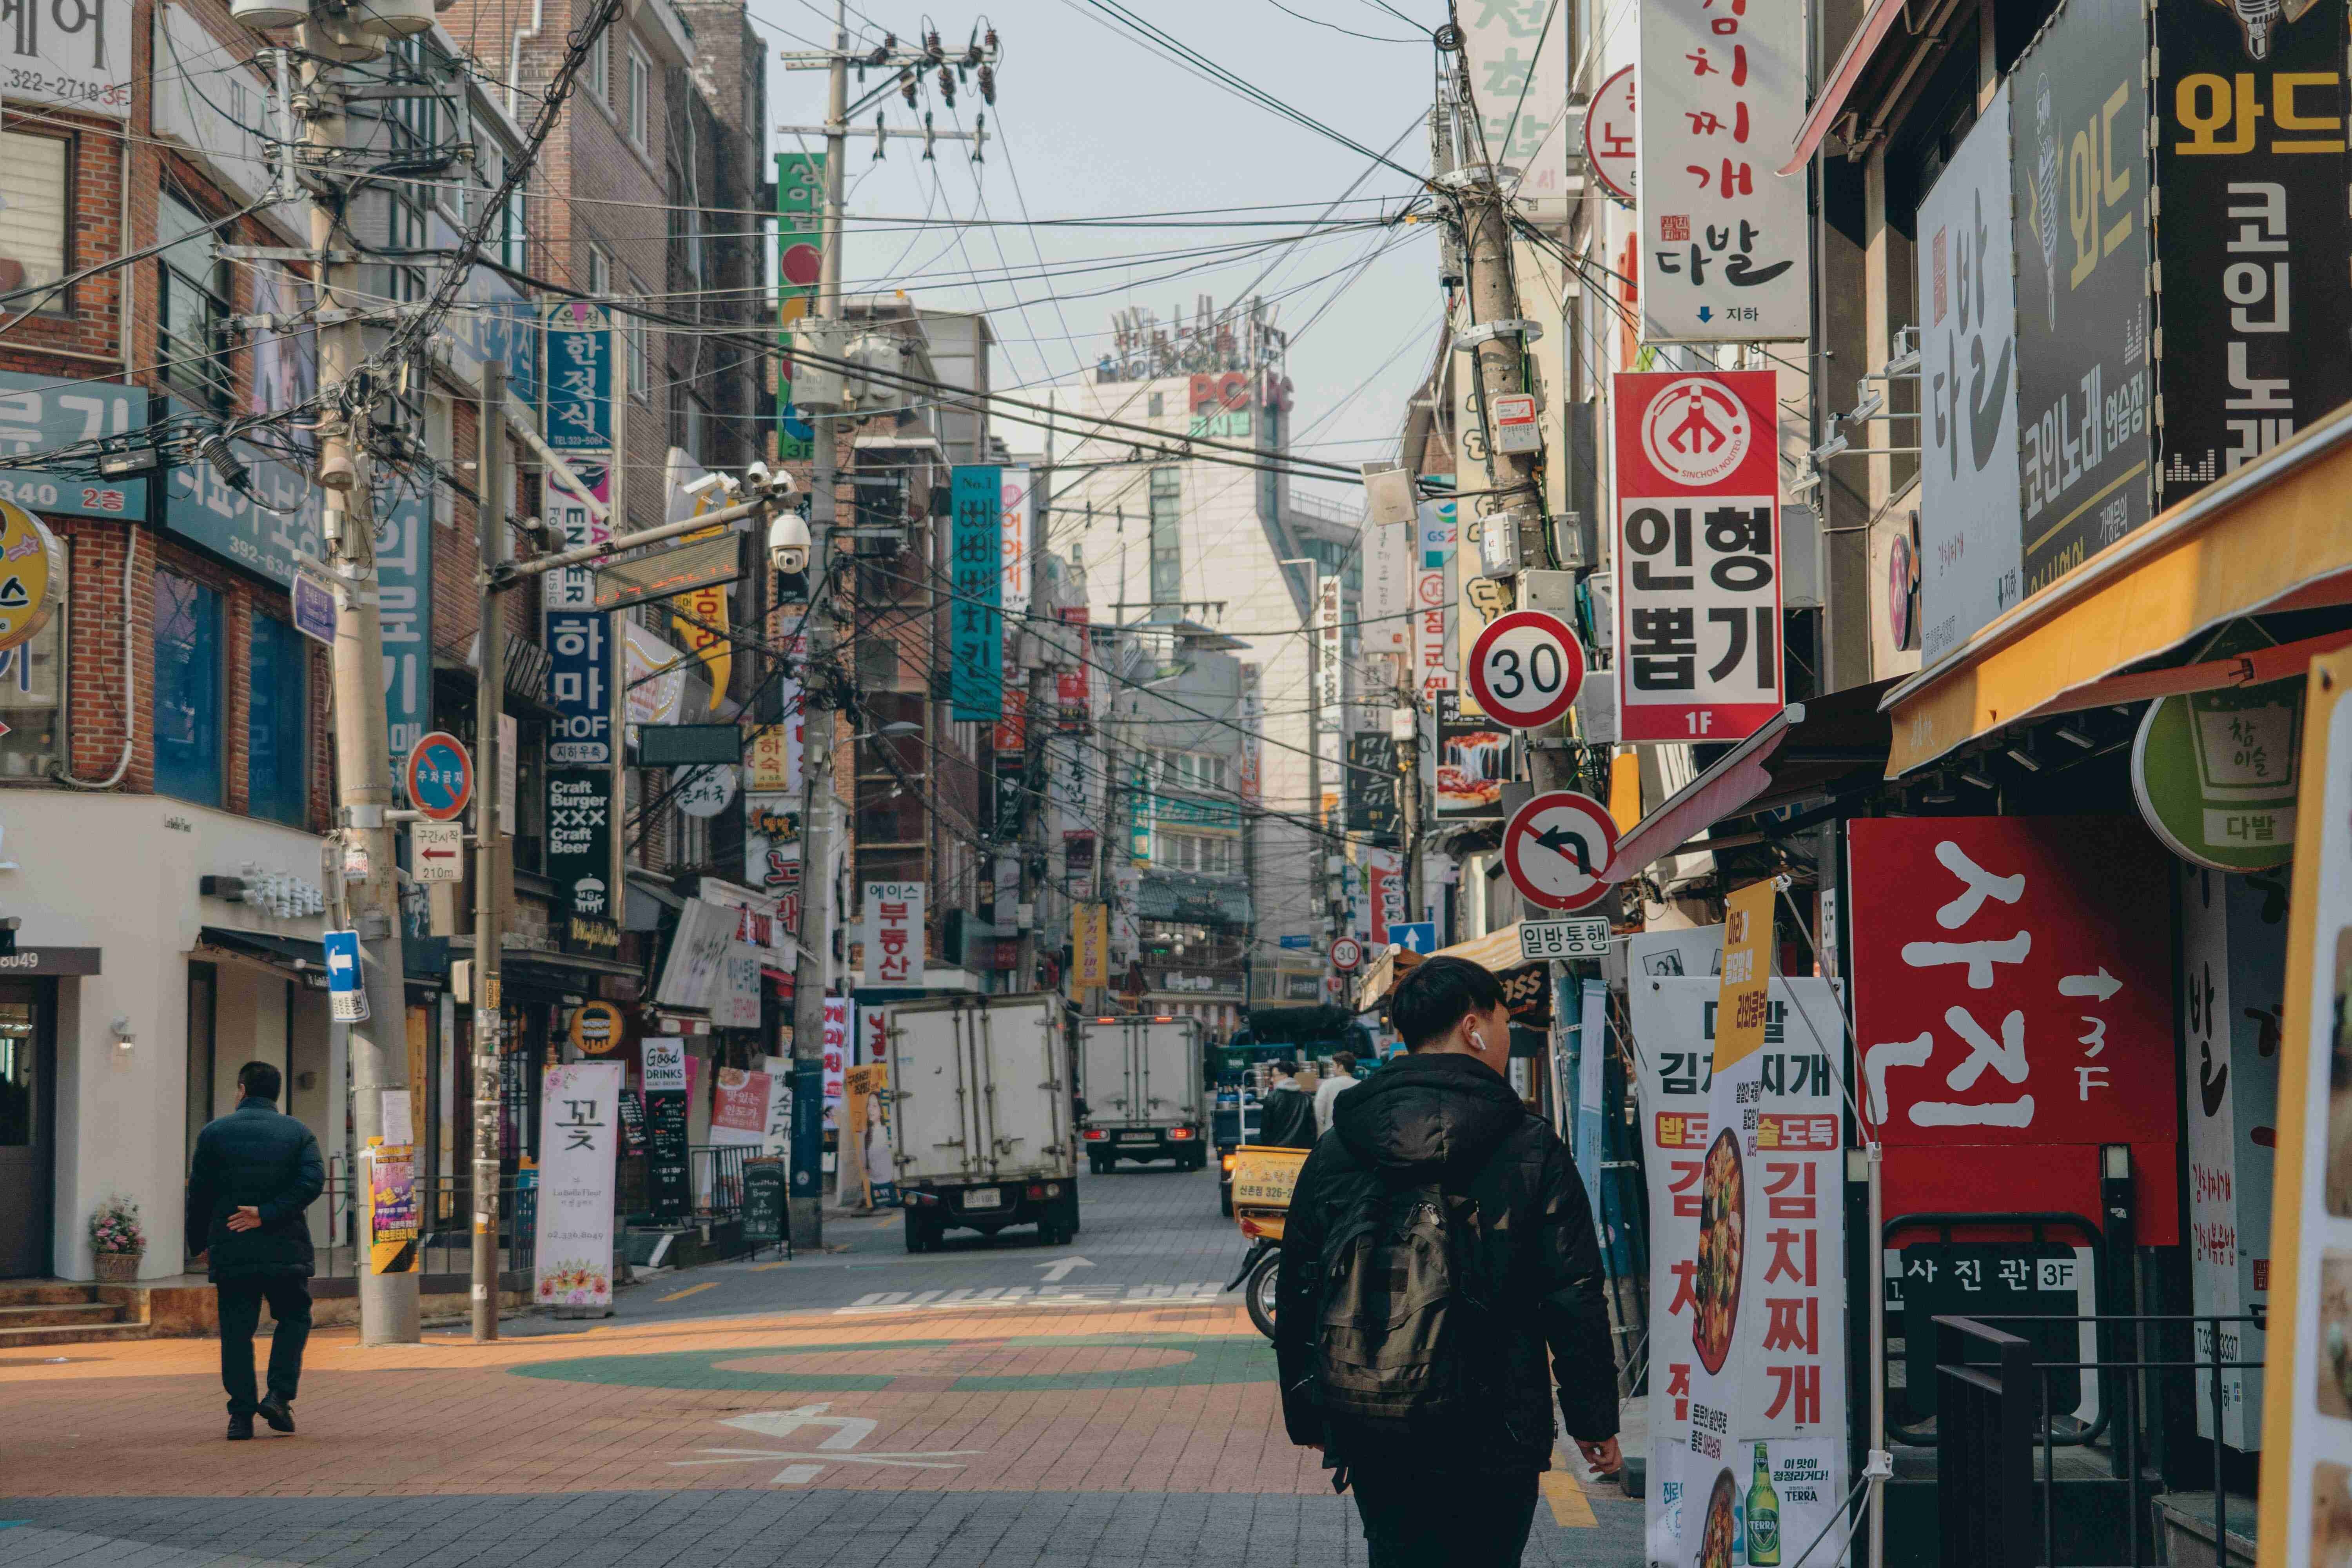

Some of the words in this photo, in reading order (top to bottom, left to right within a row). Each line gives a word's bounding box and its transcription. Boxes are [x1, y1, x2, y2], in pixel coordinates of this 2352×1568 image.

[2175, 73, 2345, 154] 와드
[2070, 80, 2132, 292] 와드
[1655, 219, 1794, 286] 다발
[1726, 307, 1759, 321] 지하
[563, 333, 603, 434] 한정식
[1190, 372, 1250, 413] PC
[2026, 365, 2102, 521] 코인노래
[2106, 370, 2144, 452] 연습장
[1682, 466, 1719, 479] SINCHON
[1719, 439, 1742, 470] NOLITEO
[81, 488, 125, 512] 2층
[2099, 493, 2127, 545] 가맹문의
[1428, 529, 1456, 544] GS2
[1625, 506, 1774, 592] 인형
[229, 535, 294, 579] 392-634
[565, 508, 586, 603] ENER
[2004, 567, 2016, 600] 지하
[1630, 606, 1776, 691] 뽑기
[553, 618, 603, 710] 하마
[1491, 642, 1562, 699] 30
[550, 715, 607, 739] HOF
[1685, 711, 1712, 735] 1F
[2229, 717, 2253, 747] 참
[417, 769, 463, 784] 주차금지
[2234, 748, 2269, 777] 이슬
[551, 781, 592, 793] Craft
[551, 794, 607, 809] Burger
[552, 809, 606, 826] XXX
[2227, 815, 2276, 840] 다발
[417, 830, 459, 844] 구간시작
[551, 828, 592, 841] Craft
[551, 841, 591, 853] Beer
[423, 867, 454, 878] 210m
[869, 886, 919, 900] 에이스
[1823, 900, 1835, 939] 3F
[878, 902, 909, 982] 부동산
[1524, 923, 1608, 953] 일방통행
[1337, 948, 1356, 960] 30
[1865, 840, 2035, 1128] 사진
[646, 1048, 681, 1067] Good
[2074, 1016, 2110, 1101] 3F
[646, 1069, 683, 1079] DRINKS
[555, 1099, 606, 1151] 꽃
[1658, 1116, 1708, 1146] 밥도
[1757, 1118, 1835, 1147] 술도둑
[1240, 1185, 1263, 1197] 신촌점
[1265, 1187, 1294, 1199] 326-2
[2193, 1163, 2231, 1203] 김치찌개
[548, 1229, 604, 1240] 02.336.8049
[2193, 1222, 2235, 1267] 김치볶음밥
[1907, 1258, 2030, 1291] 사진관
[2043, 1263, 2074, 1286] 3F
[1763, 1162, 1821, 1424] 김치찌개
[1773, 1470, 1829, 1482] 청정라거다!
[1784, 1459, 1795, 1470] 이
[1797, 1458, 1818, 1470] 맛이
[1784, 1491, 1818, 1503] TERRA
[1749, 1520, 1777, 1530] TERRA
